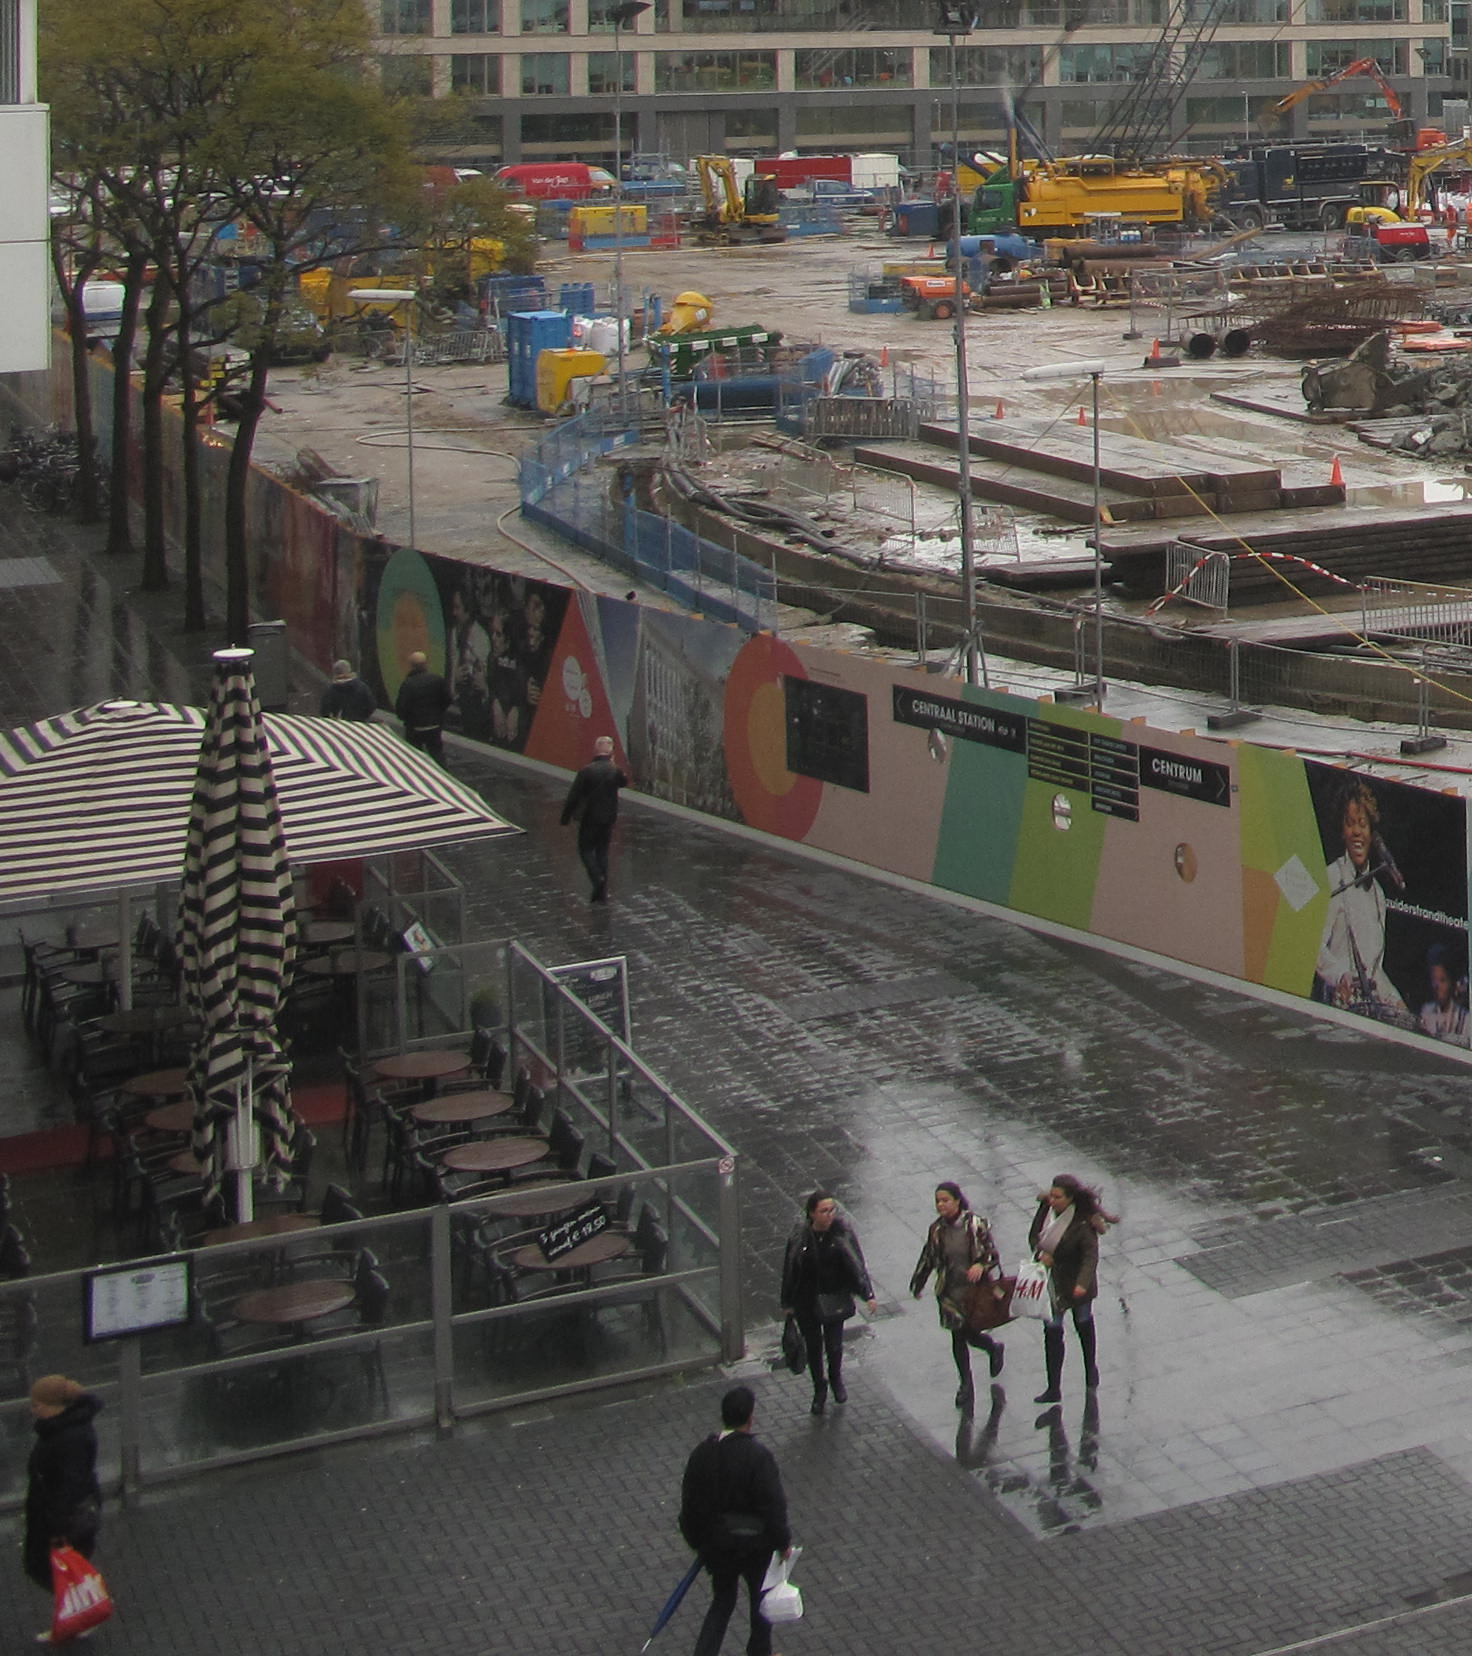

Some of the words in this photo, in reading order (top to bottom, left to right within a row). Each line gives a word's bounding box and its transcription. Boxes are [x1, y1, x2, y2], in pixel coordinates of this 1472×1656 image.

[911, 698, 956, 722] CENTRAAL
[958, 710, 995, 733] STATION
[1151, 757, 1203, 784] CENTRUM
